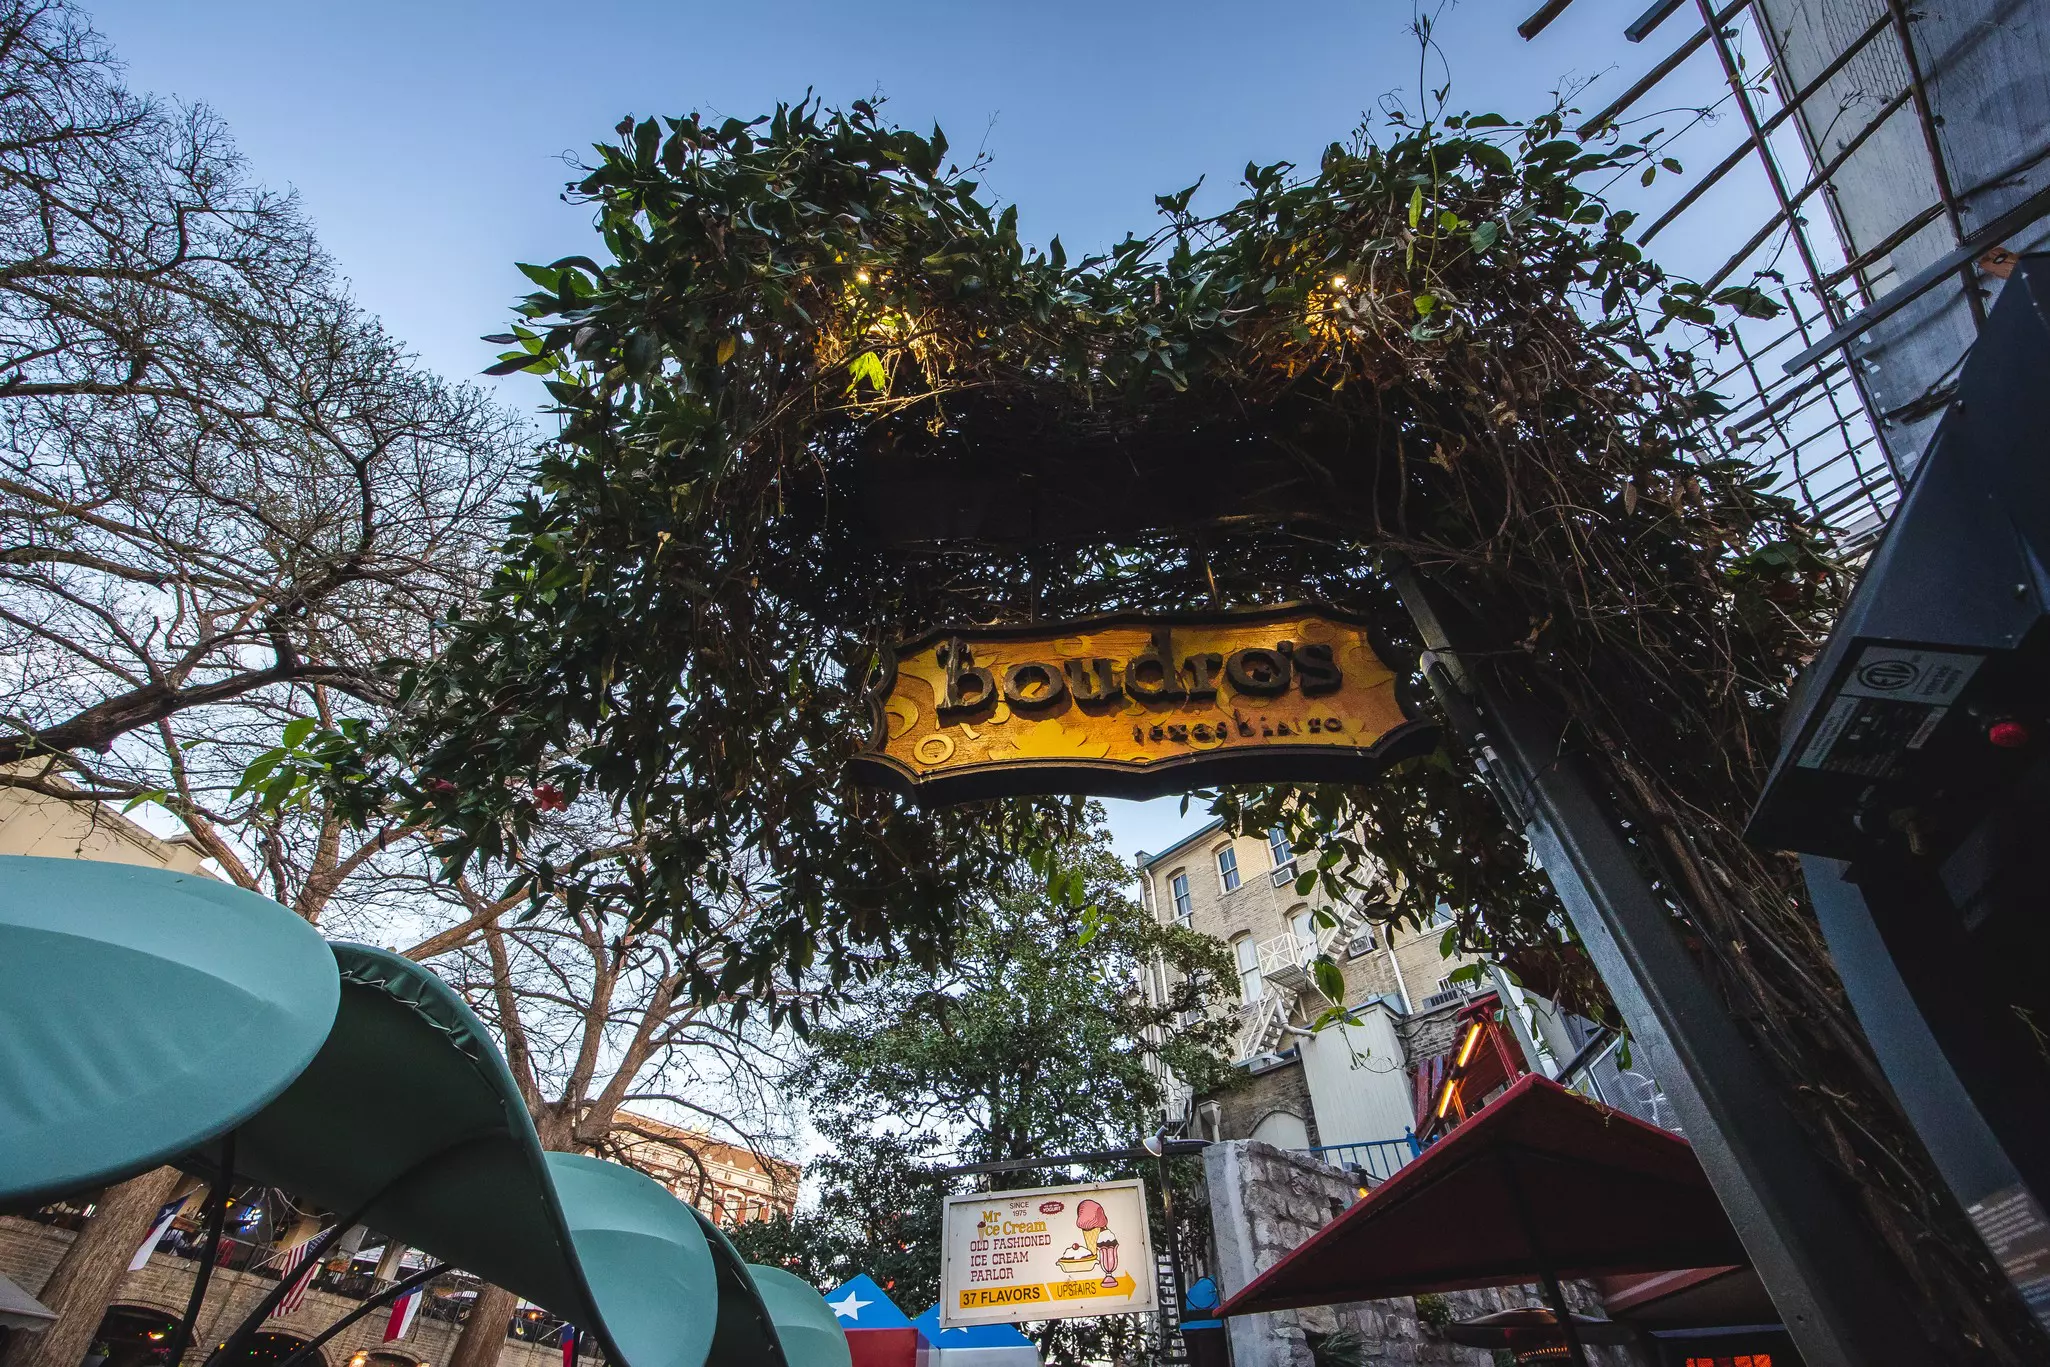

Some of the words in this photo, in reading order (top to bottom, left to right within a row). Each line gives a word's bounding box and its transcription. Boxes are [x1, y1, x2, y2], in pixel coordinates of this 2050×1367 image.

[936, 629, 1342, 714] boudro's
[1009, 1201, 1029, 1209] SINCE
[1013, 1209, 1027, 1217] 1975
[982, 1210, 1001, 1223] Mr
[1003, 1220, 1047, 1235] Cream
[970, 1240, 989, 1252] OLD
[994, 1234, 1051, 1250] FASHIONED
[970, 1254, 987, 1267] ICE
[992, 1250, 1029, 1265] CREAM
[970, 1268, 1013, 1282] PARLOR
[963, 1292, 977, 1305] 37
[981, 1286, 1040, 1304] FLAVORS
[1057, 1281, 1097, 1298] UPSTAIRS
